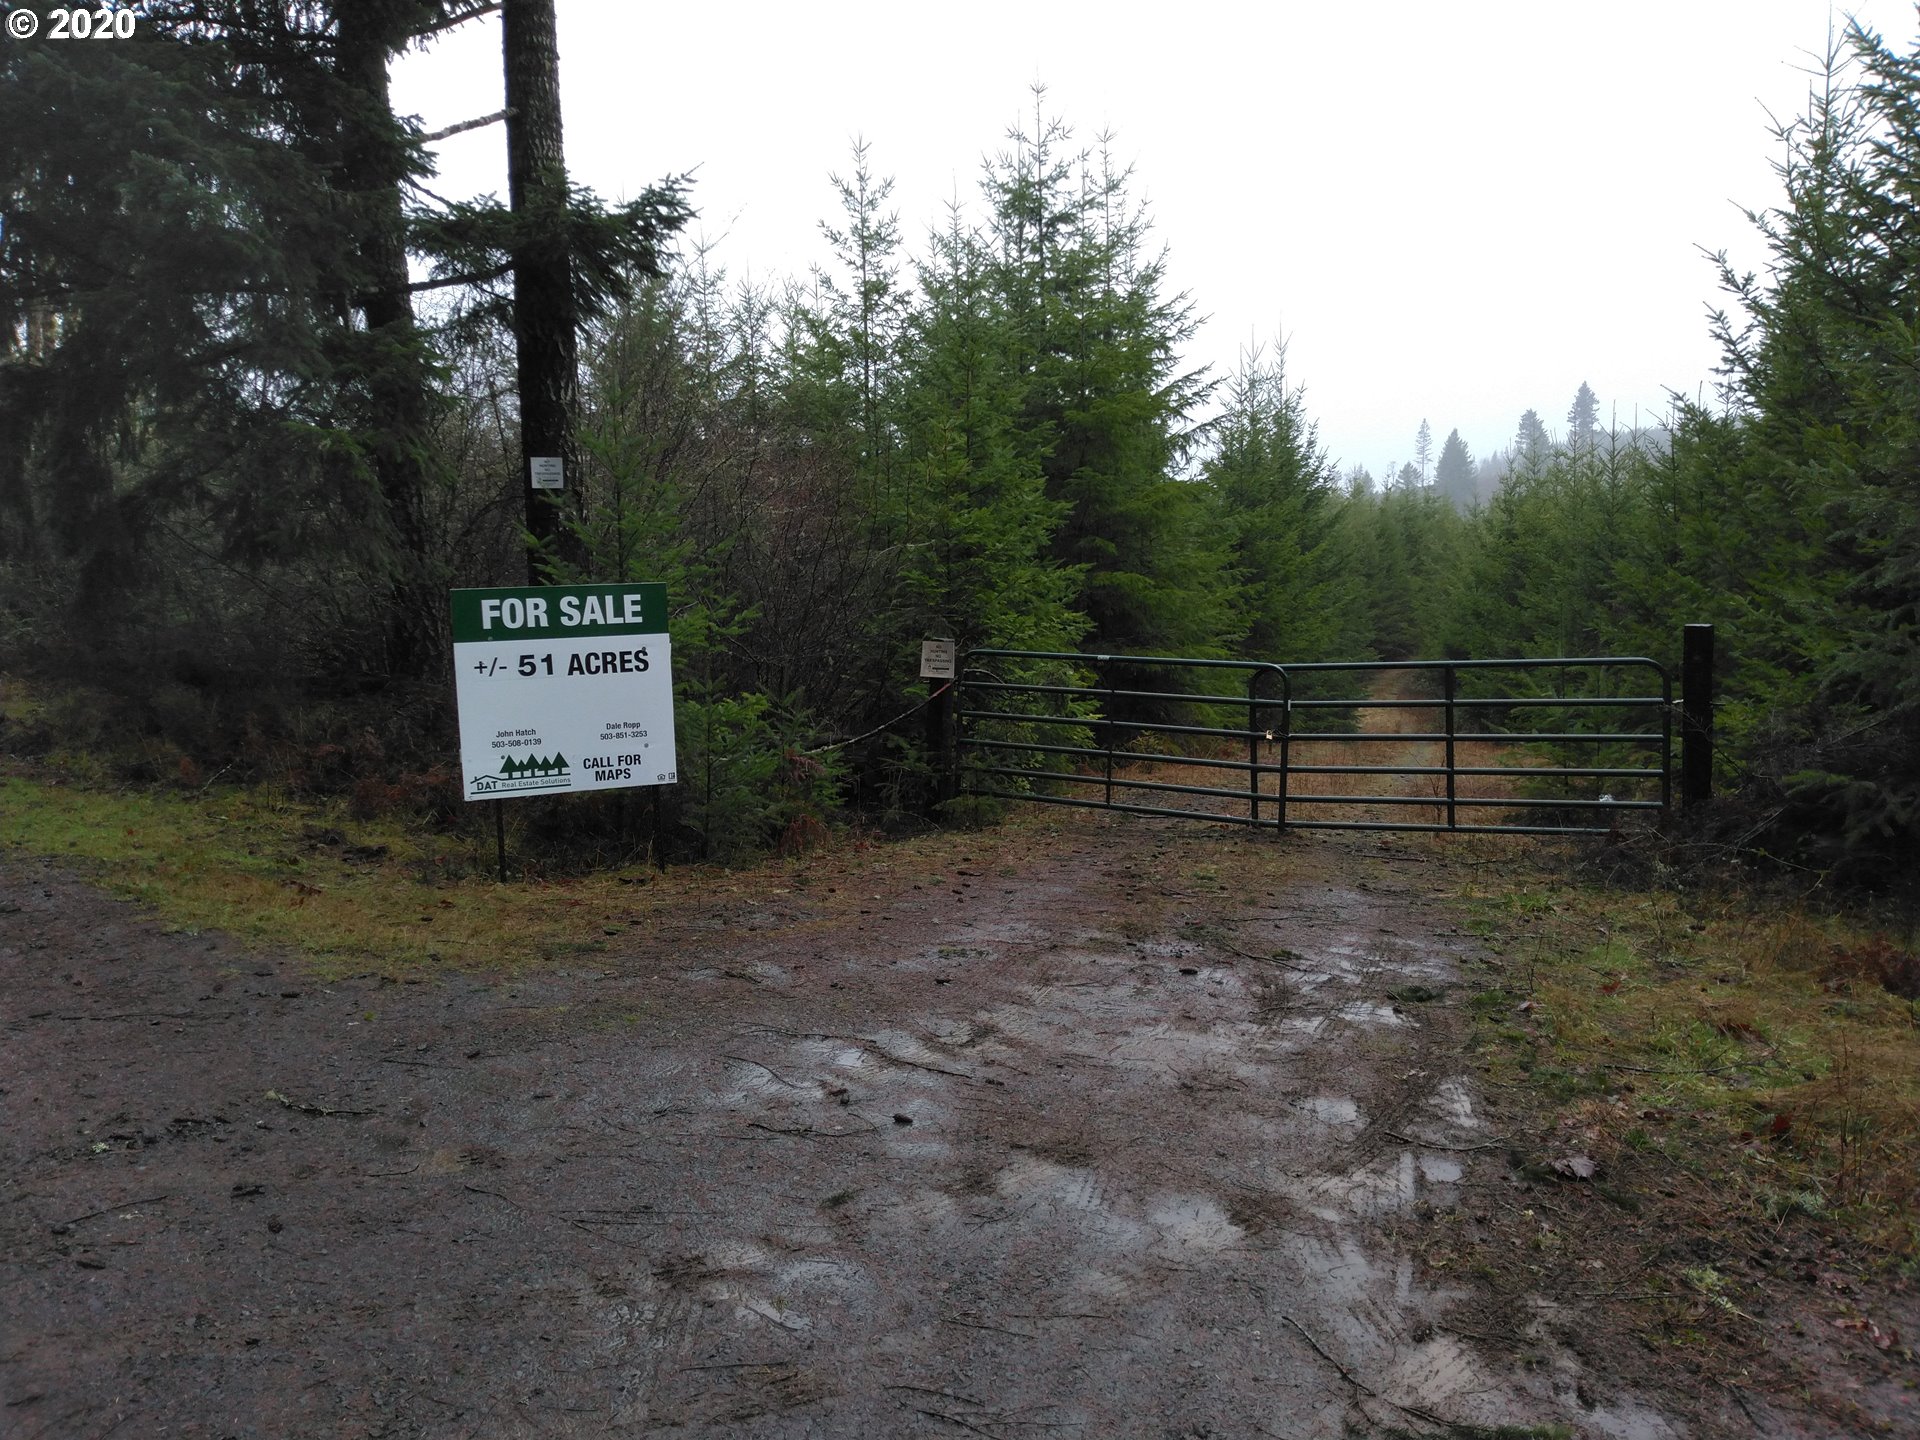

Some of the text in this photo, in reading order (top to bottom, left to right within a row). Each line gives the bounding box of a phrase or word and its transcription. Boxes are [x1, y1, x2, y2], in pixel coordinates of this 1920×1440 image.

[481, 594, 643, 630] FOR SALE
[474, 650, 650, 677] +/- 51 ACRES
[496, 728, 537, 738] John Hatch
[606, 721, 641, 731] Dale Ropp
[600, 730, 648, 740] 503-851-3253
[491, 738, 542, 748] 503-508-0139
[583, 754, 642, 768] CALL FOR
[595, 768, 631, 782] MAPS
[476, 776, 571, 791] DAT Real Estate Solutions
